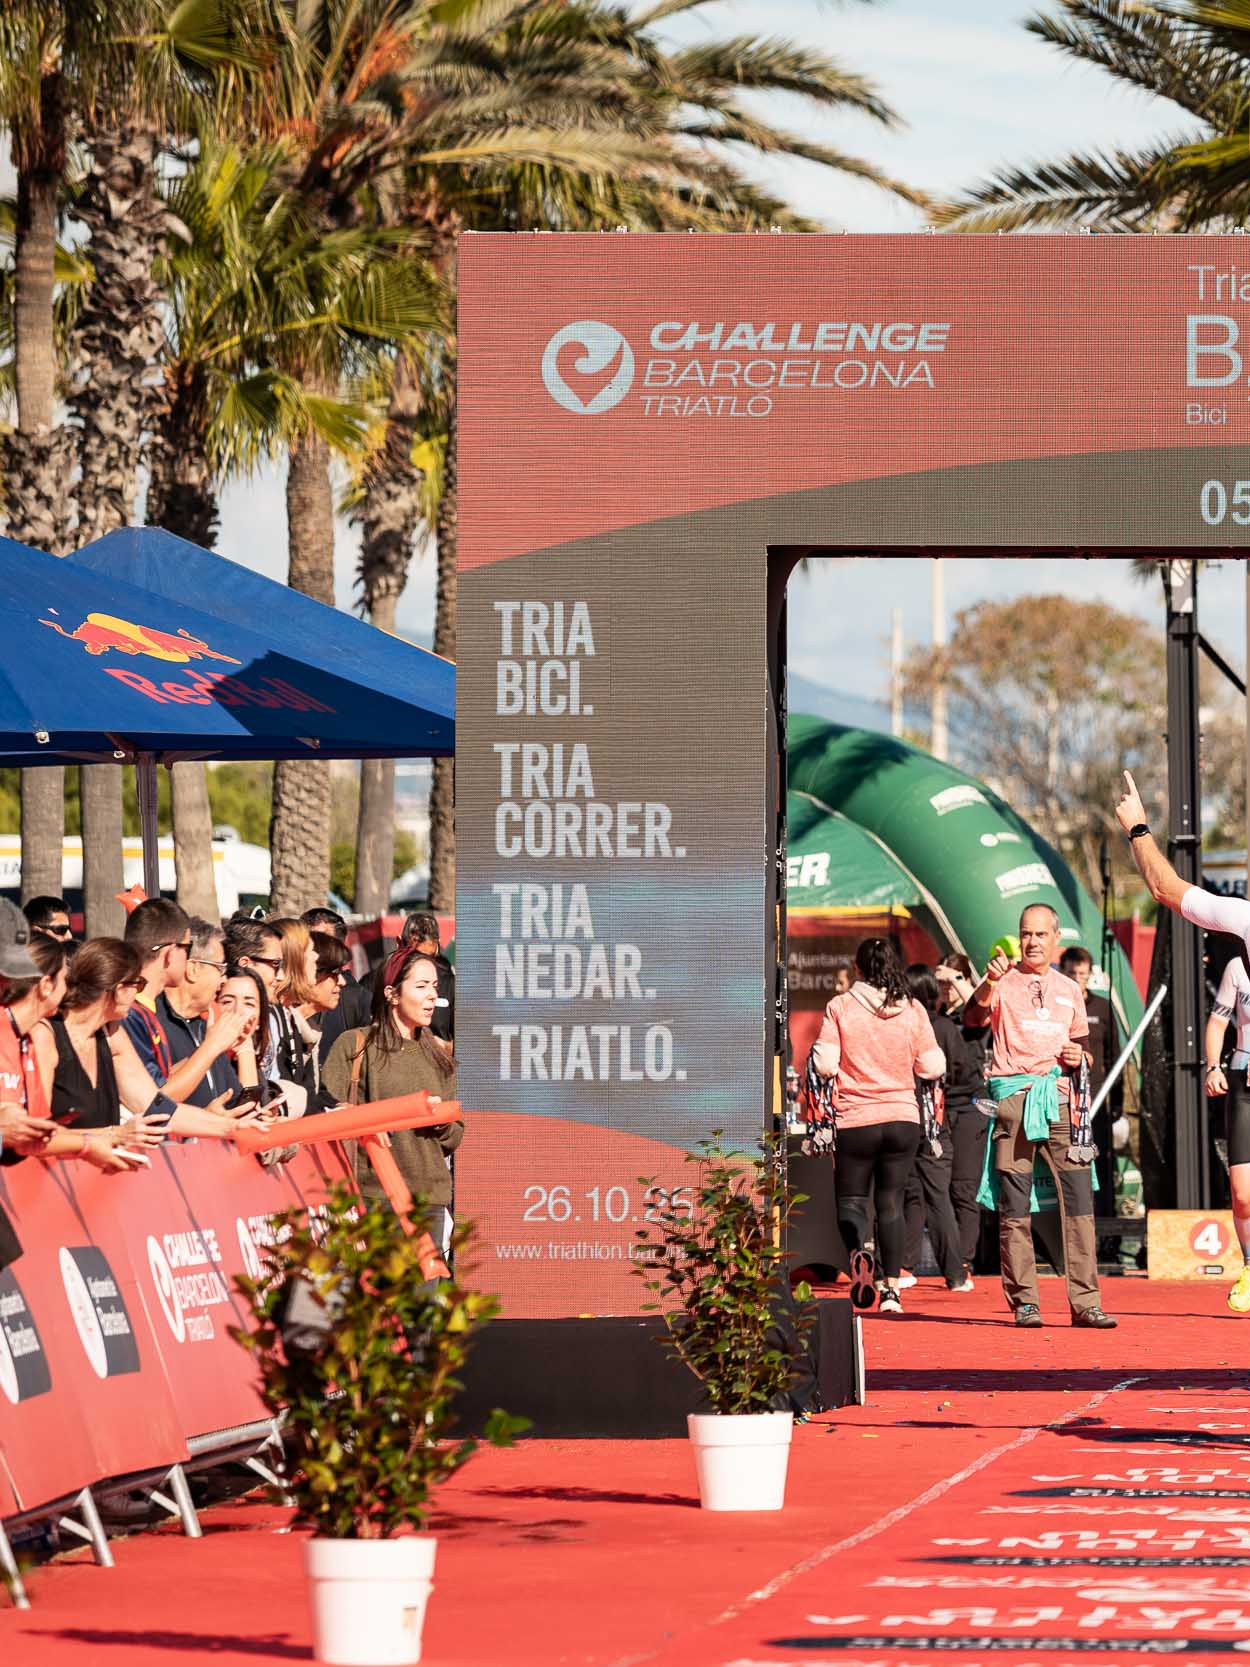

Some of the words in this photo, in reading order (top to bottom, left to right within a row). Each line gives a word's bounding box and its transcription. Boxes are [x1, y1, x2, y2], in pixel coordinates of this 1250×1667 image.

[649, 321, 951, 352] CHALLENGE
[642, 359, 937, 389] BARCELONA
[1185, 403, 1229, 426] Bici
[493, 601, 596, 656] TRIA
[102, 668, 230, 705] Red
[205, 671, 337, 714] Bull
[496, 659, 594, 716] BICI.
[493, 743, 595, 798] TRIA
[492, 883, 595, 938] TRIA
[495, 943, 657, 1000] NEDAR.
[522, 1184, 697, 1223] 26.10.25
[1193, 1223, 1223, 1256] 4
